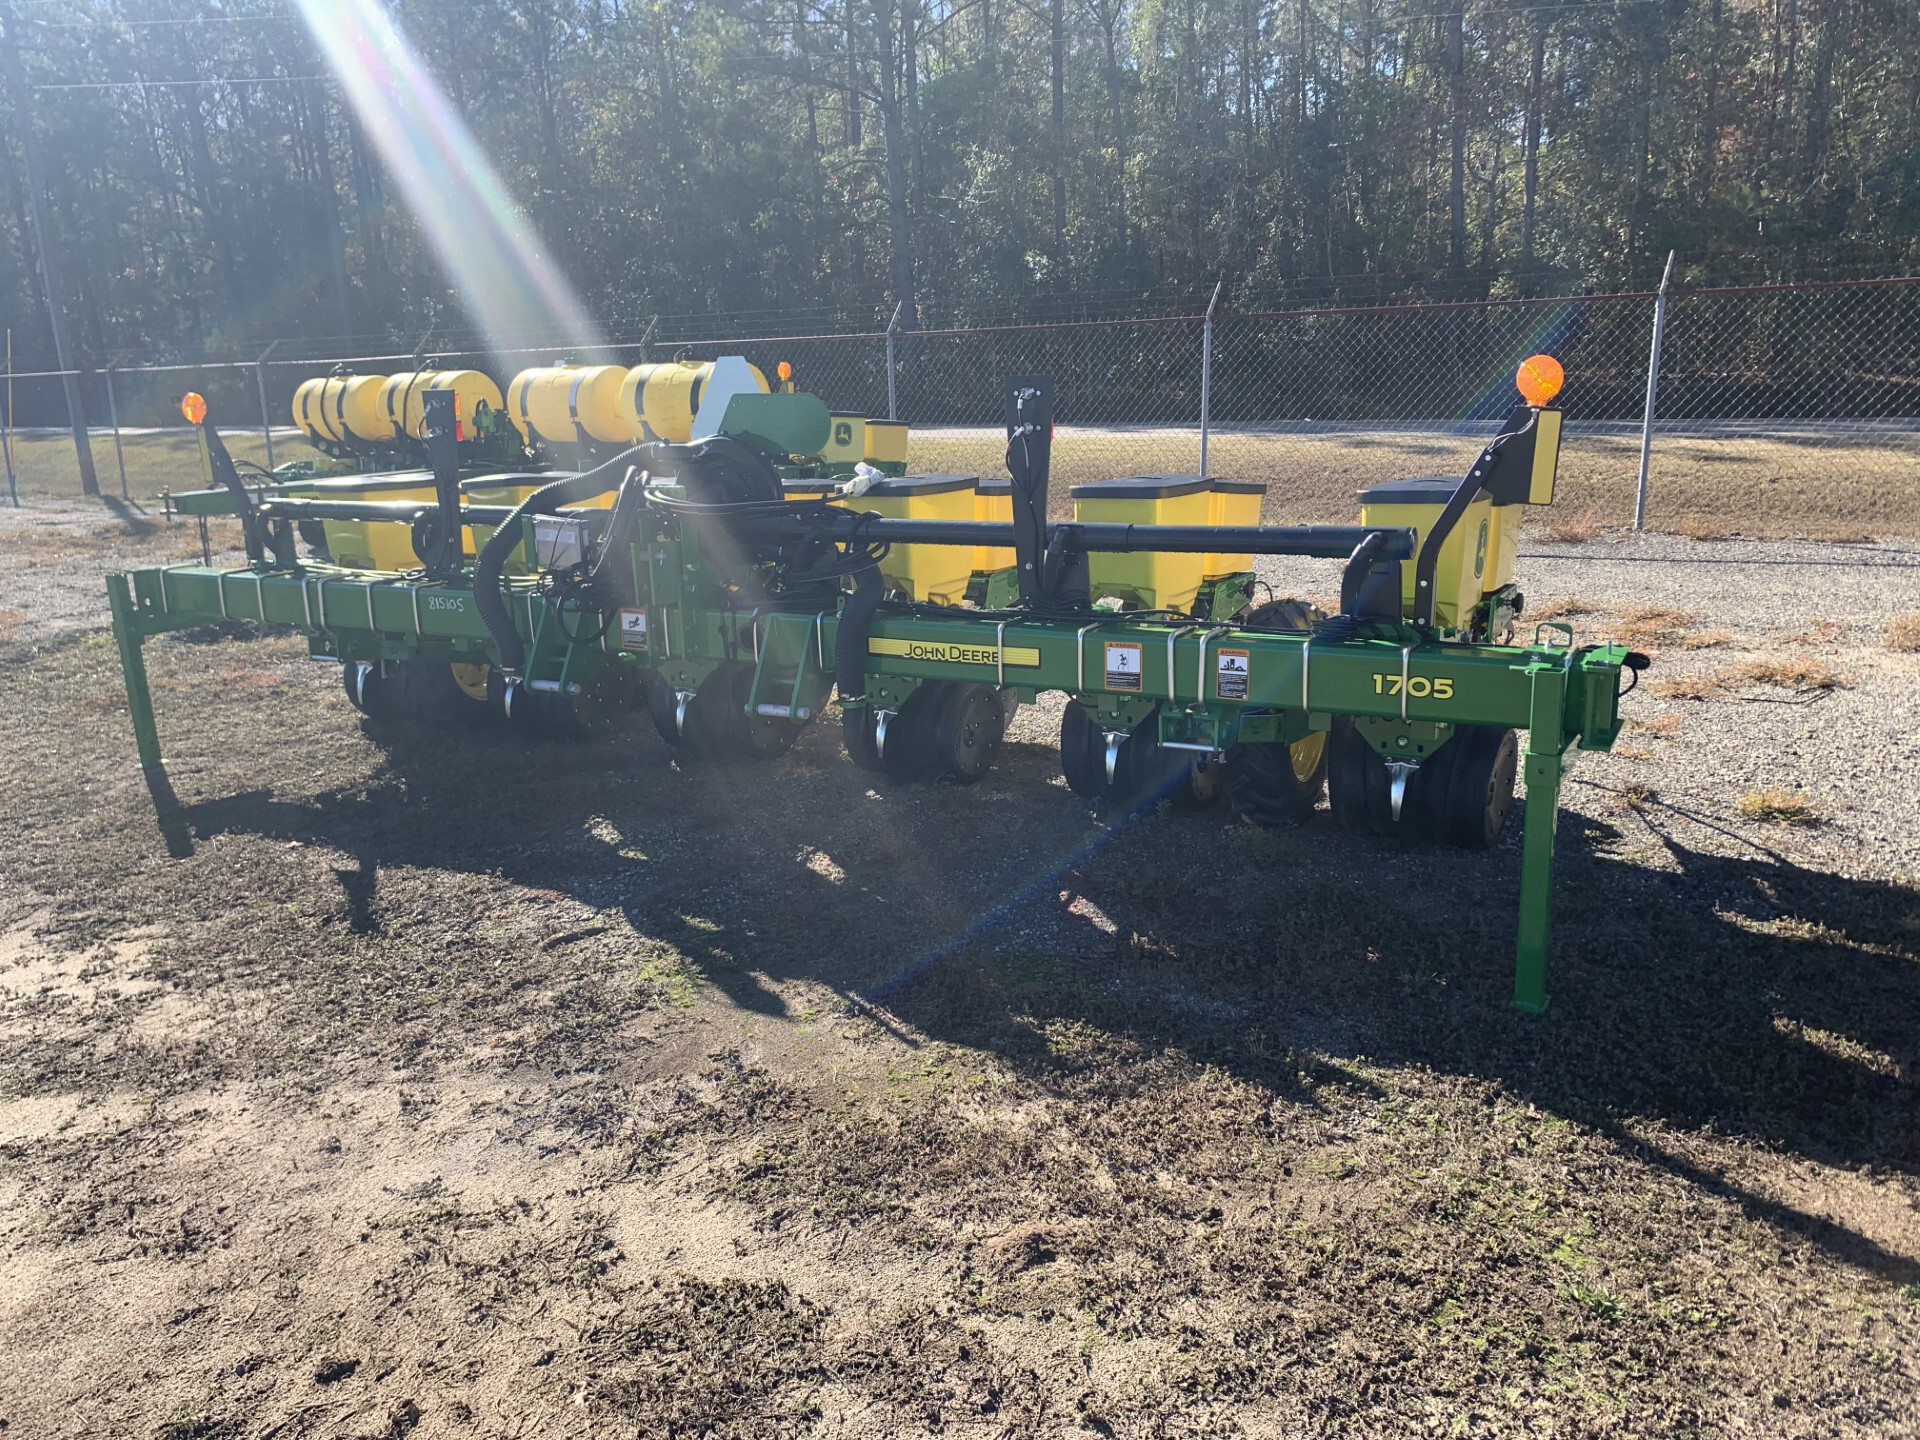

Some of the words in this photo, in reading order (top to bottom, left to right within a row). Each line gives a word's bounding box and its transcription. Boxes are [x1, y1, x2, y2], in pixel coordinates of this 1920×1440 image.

[904, 643, 946, 659] JOHN
[949, 646, 999, 663] DEERE
[1372, 673, 1454, 700] 1705
